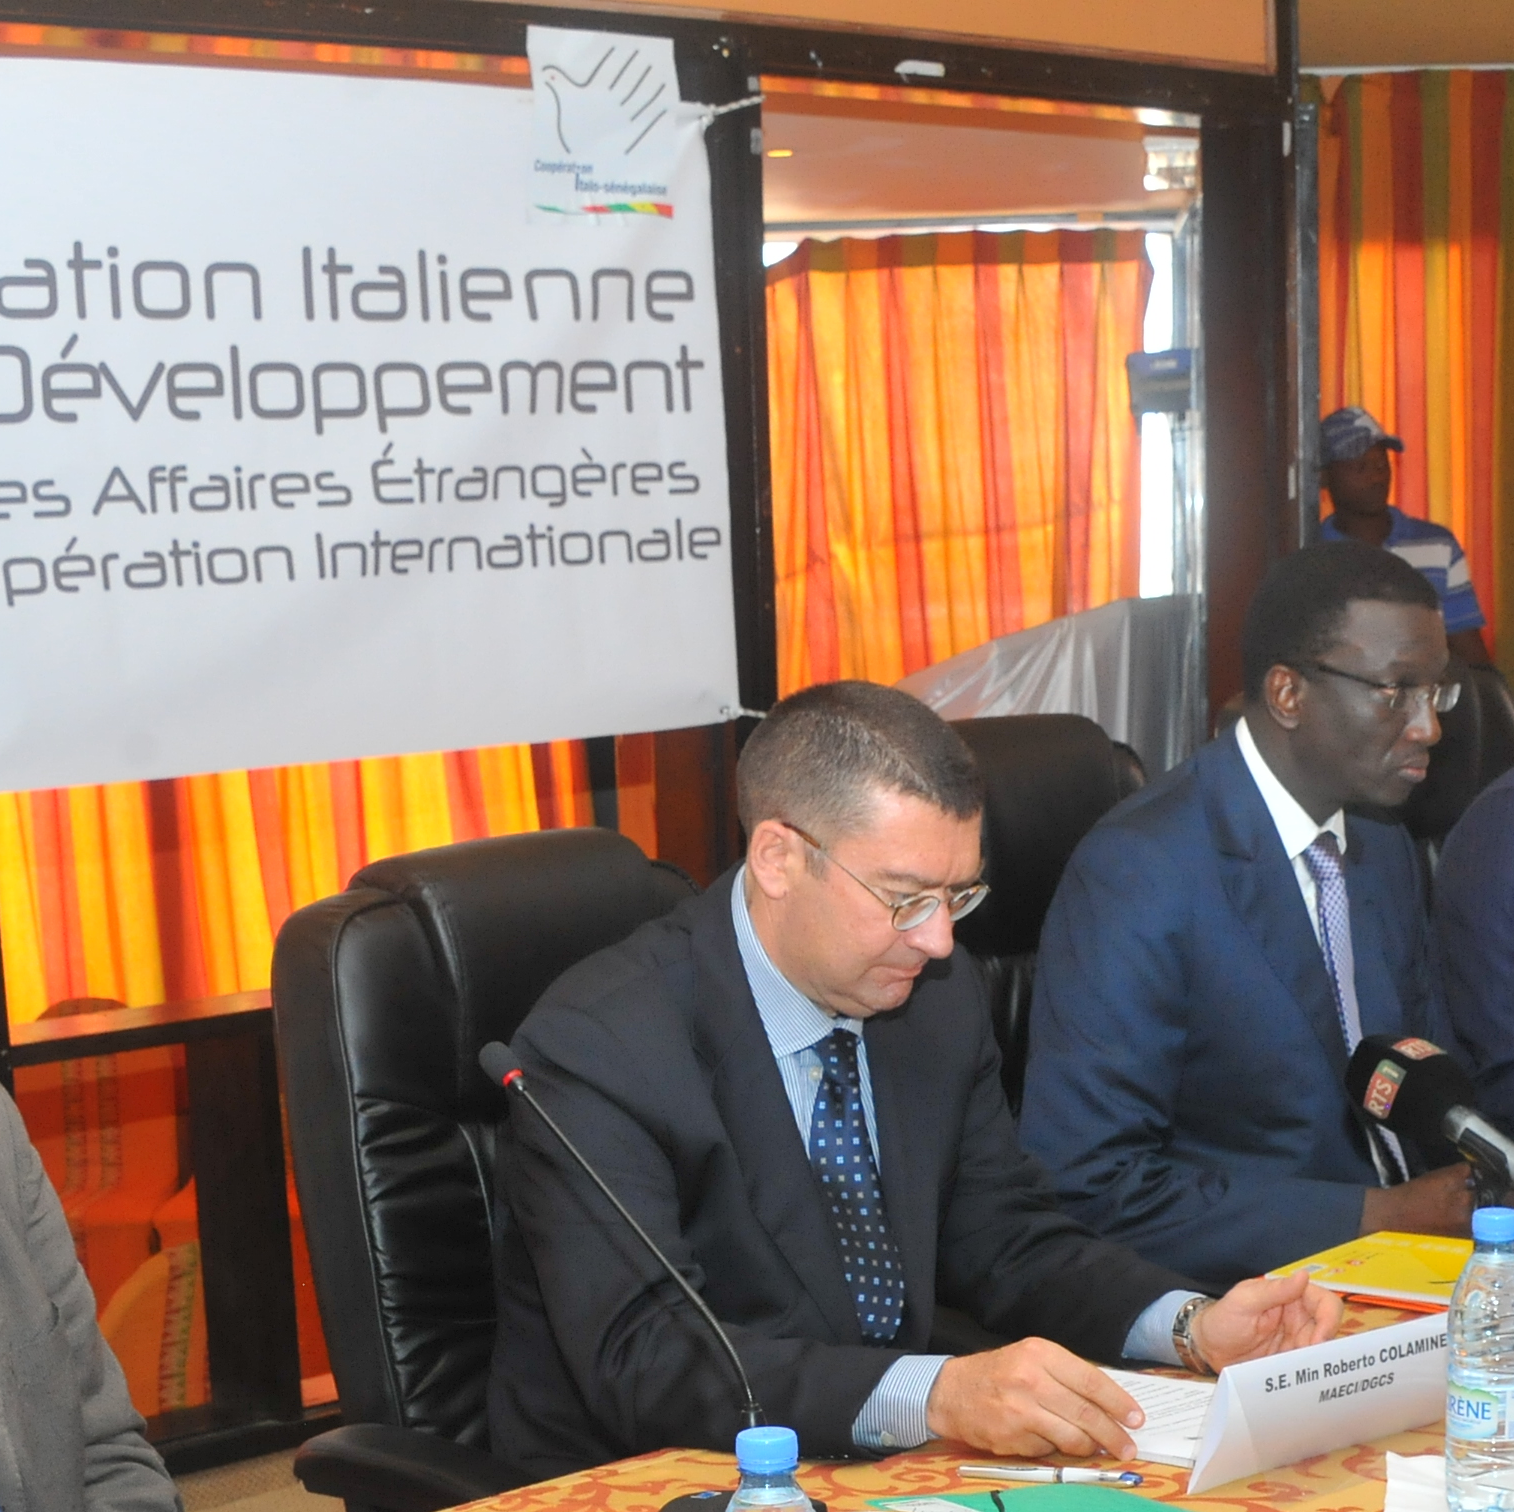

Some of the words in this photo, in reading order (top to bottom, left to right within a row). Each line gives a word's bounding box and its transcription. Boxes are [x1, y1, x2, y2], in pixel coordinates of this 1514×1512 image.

[302, 246, 694, 322] Italienne
[93, 465, 353, 515] Affaires
[372, 442, 700, 508] Étrangères
[316, 518, 722, 580] Internationale
[1368, 1079, 1393, 1116] RTS
[1265, 1373, 1291, 1393] S.E.
[1295, 1366, 1319, 1386] Min
[1323, 1353, 1376, 1378] Roberto
[1379, 1333, 1448, 1363] COLAMINE
[1448, 1395, 1492, 1420] RÈNE
